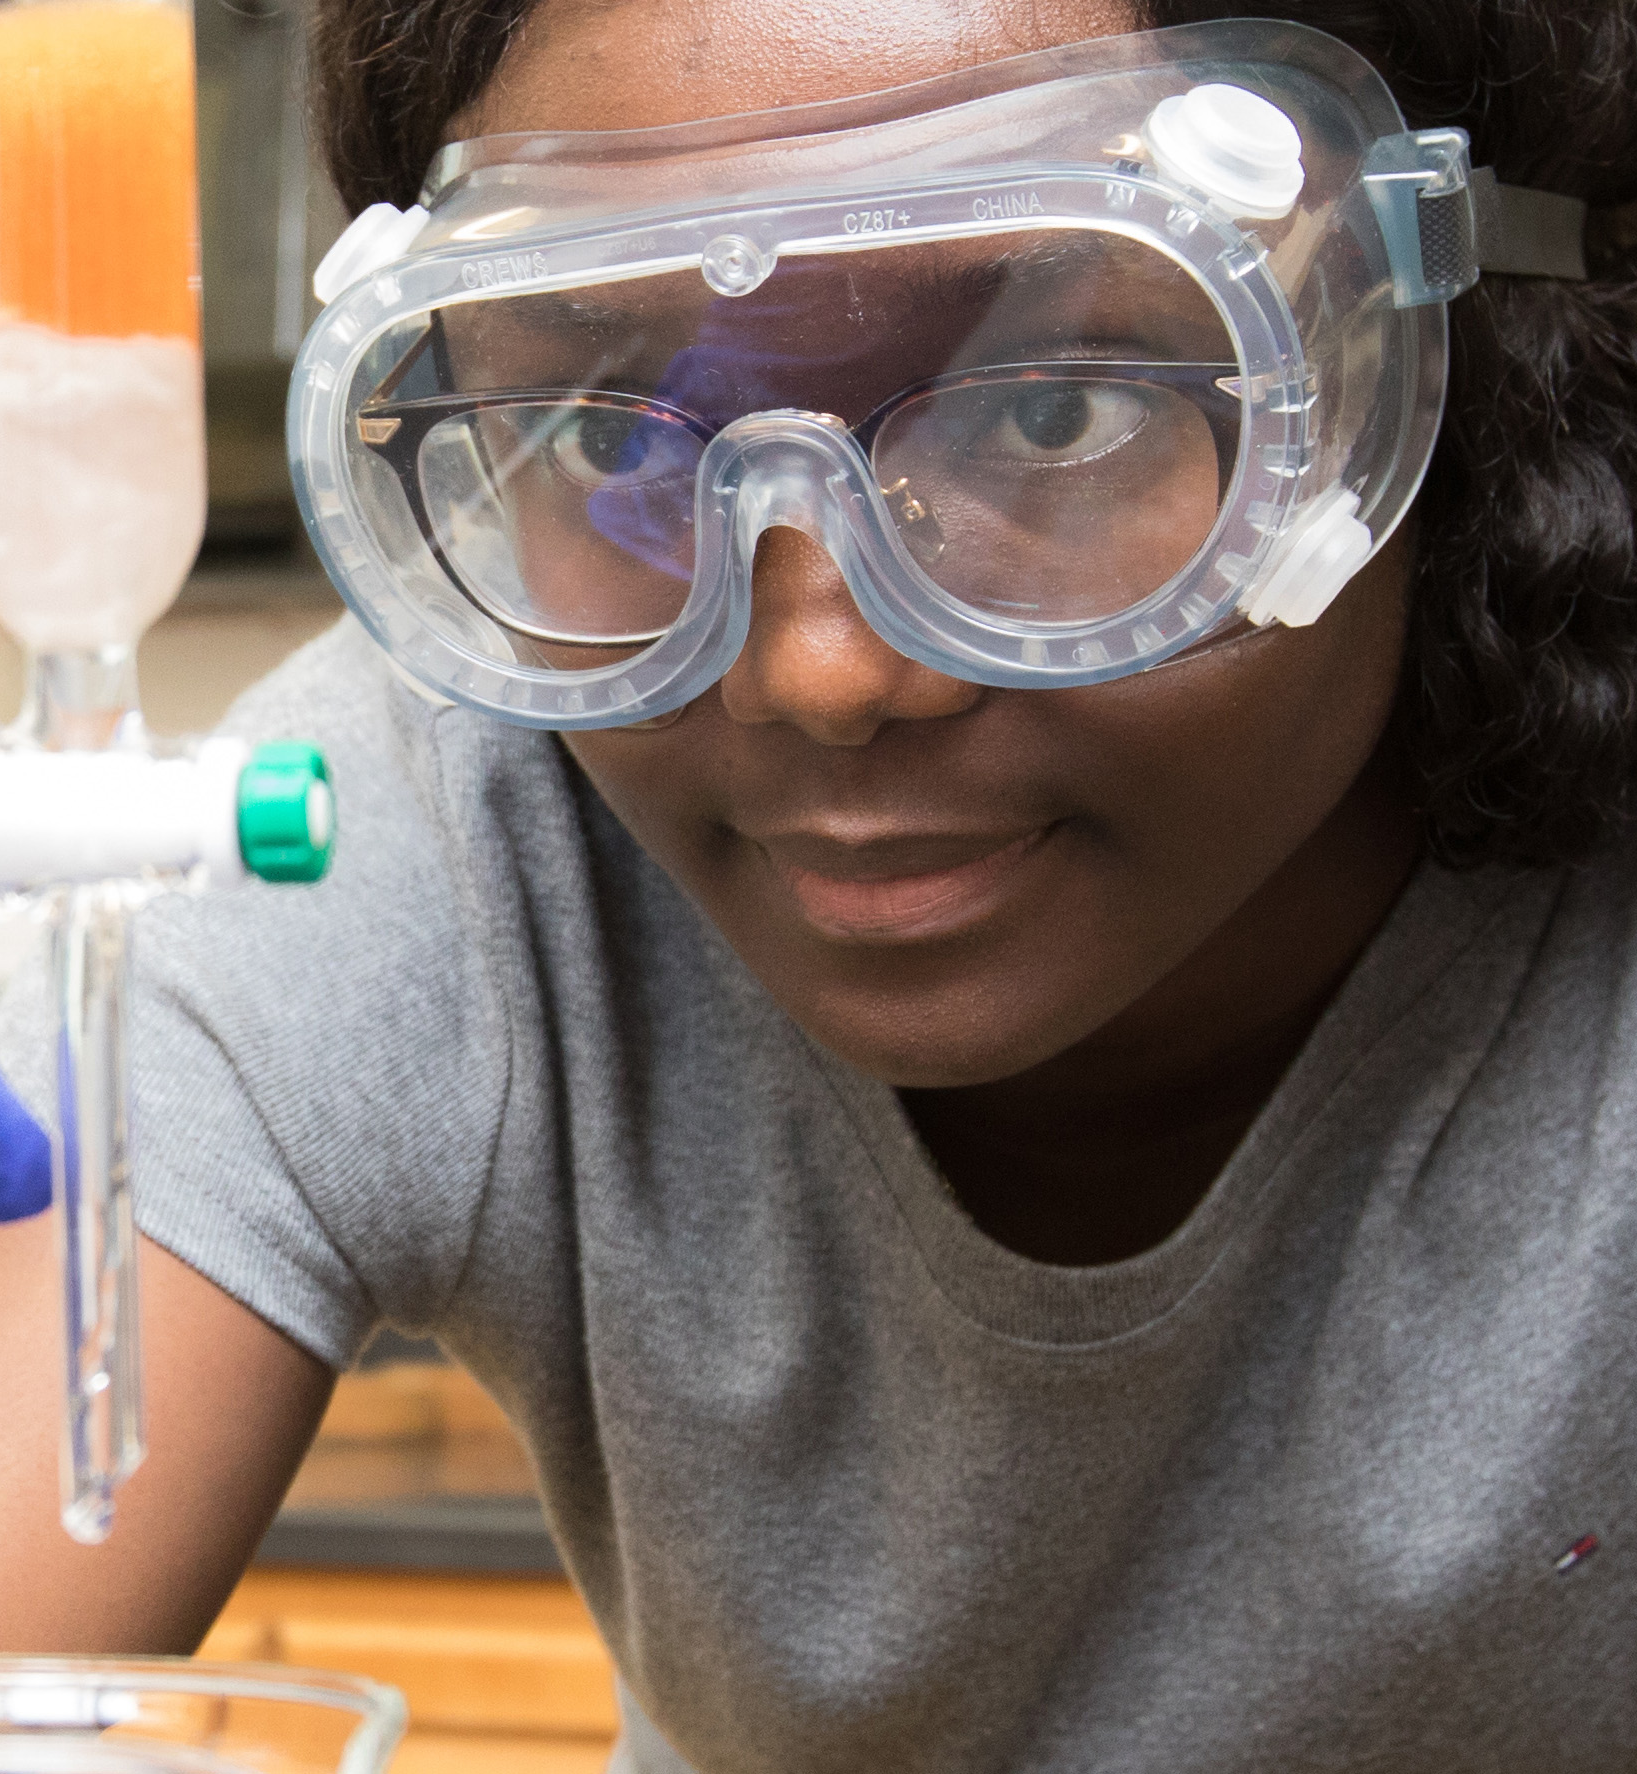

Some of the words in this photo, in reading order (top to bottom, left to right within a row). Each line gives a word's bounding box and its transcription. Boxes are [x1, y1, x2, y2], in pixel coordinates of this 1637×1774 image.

[843, 209, 911, 234] CZ87+
[972, 191, 1045, 220] CHINA
[461, 252, 549, 289] CREWS
